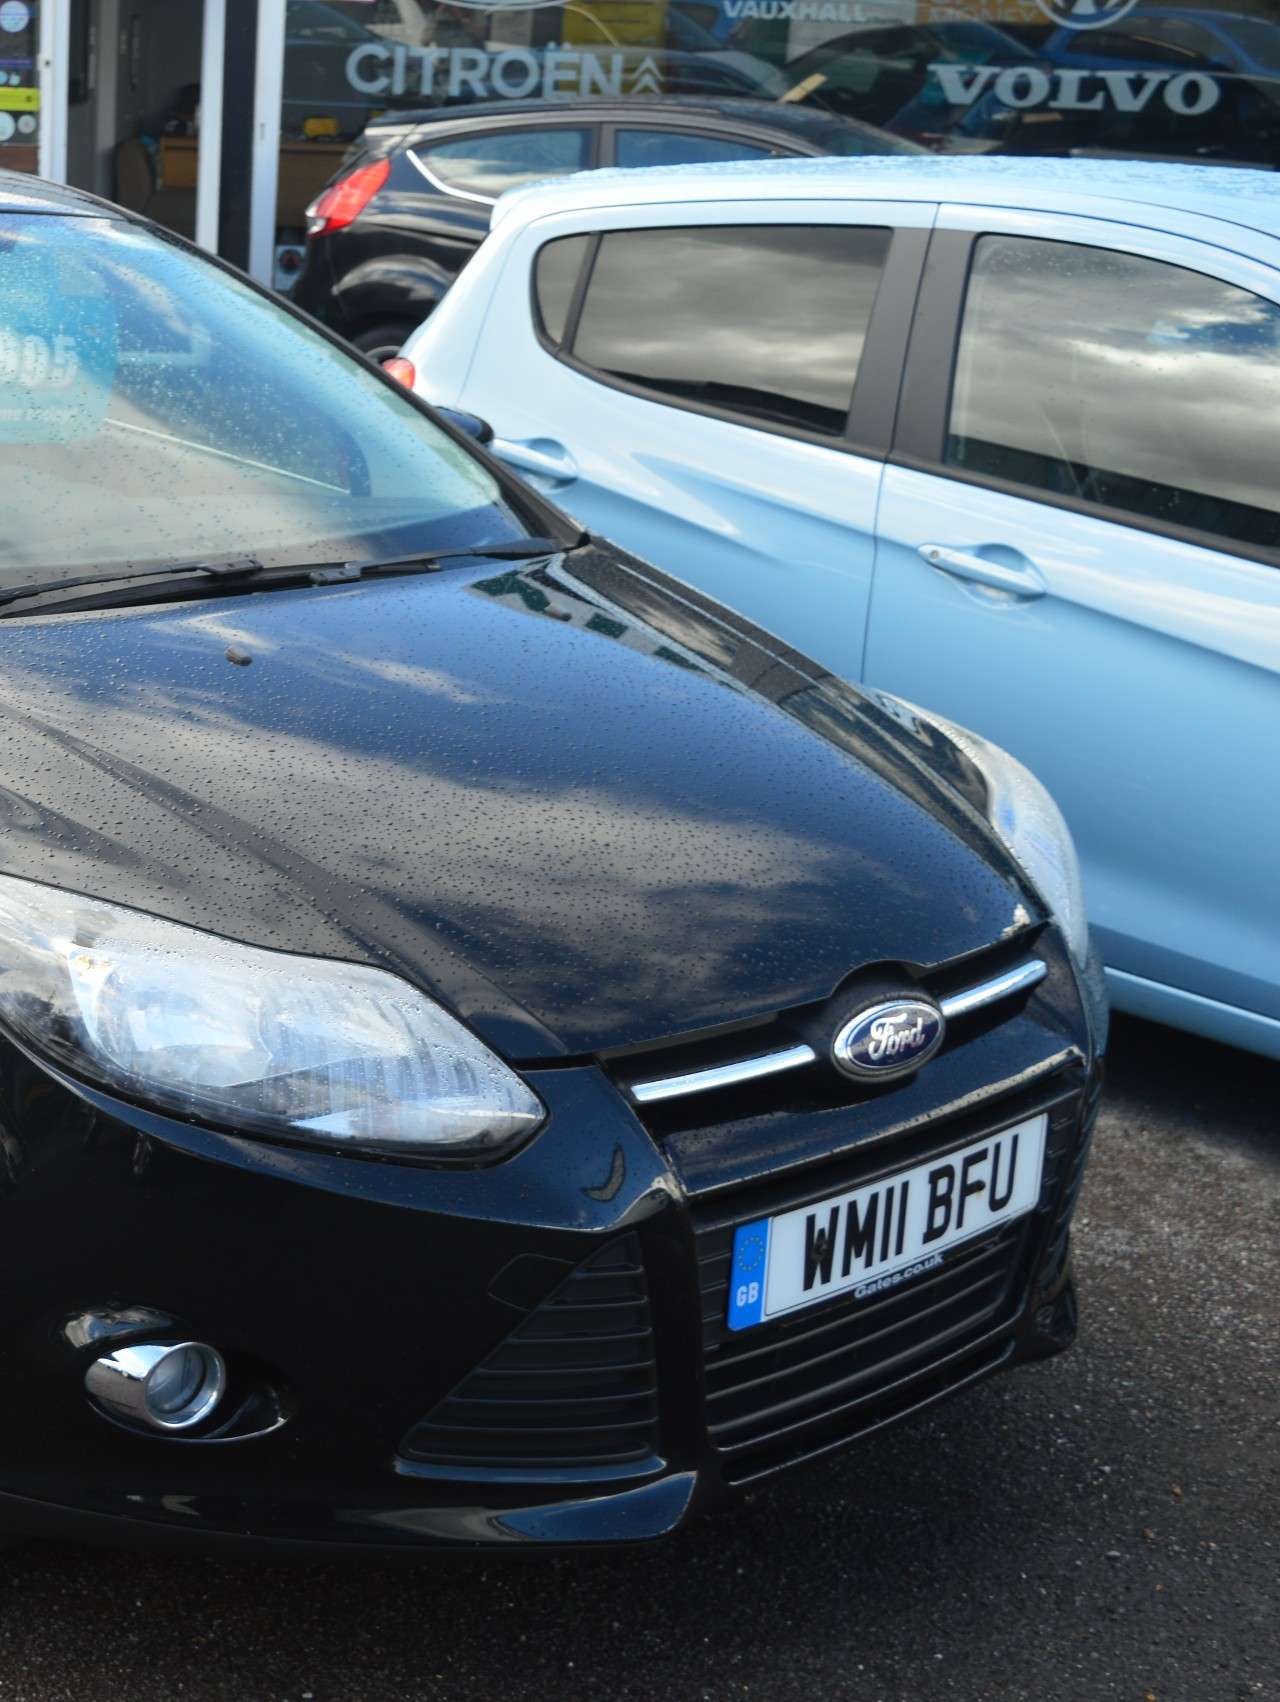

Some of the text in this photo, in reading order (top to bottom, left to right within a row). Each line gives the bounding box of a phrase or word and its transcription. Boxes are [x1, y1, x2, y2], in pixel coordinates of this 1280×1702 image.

[723, 0, 867, 22] VAUXHALL
[345, 41, 624, 99] CITROËN
[926, 63, 1220, 116] VOLVO
[868, 1013, 926, 1061] Ford
[803, 1133, 1020, 1292] WM11 BFU
[736, 1281, 760, 1307] GB
[853, 1251, 945, 1300] Gates.co.uk
